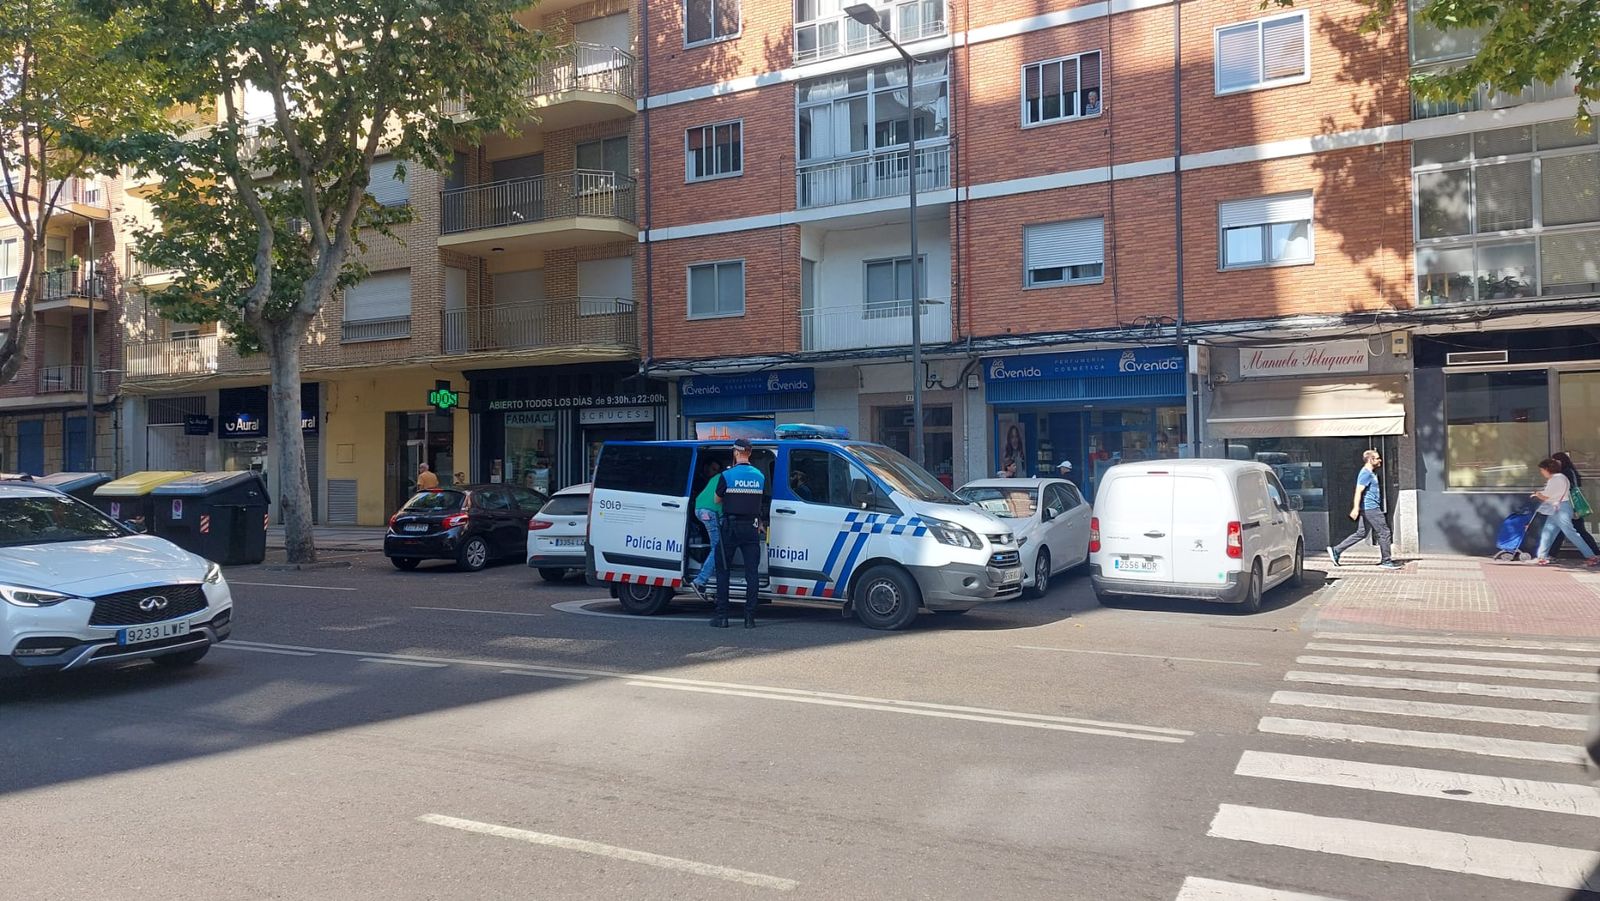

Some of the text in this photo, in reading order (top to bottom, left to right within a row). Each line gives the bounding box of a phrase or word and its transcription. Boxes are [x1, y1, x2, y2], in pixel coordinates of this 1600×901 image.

[1243, 350, 1298, 370] Manuela
[489, 400, 524, 410] ABIERTO
[525, 399, 553, 408] TODOS
[554, 398, 572, 407] LOS
[572, 395, 593, 406] DÍAS
[595, 396, 605, 405] de
[235, 417, 260, 431] Aural
[301, 415, 316, 429] ural
[626, 535, 683, 553] Policía Mu
[769, 545, 809, 563] nicipal
[128, 622, 186, 642] 9233 LWF
